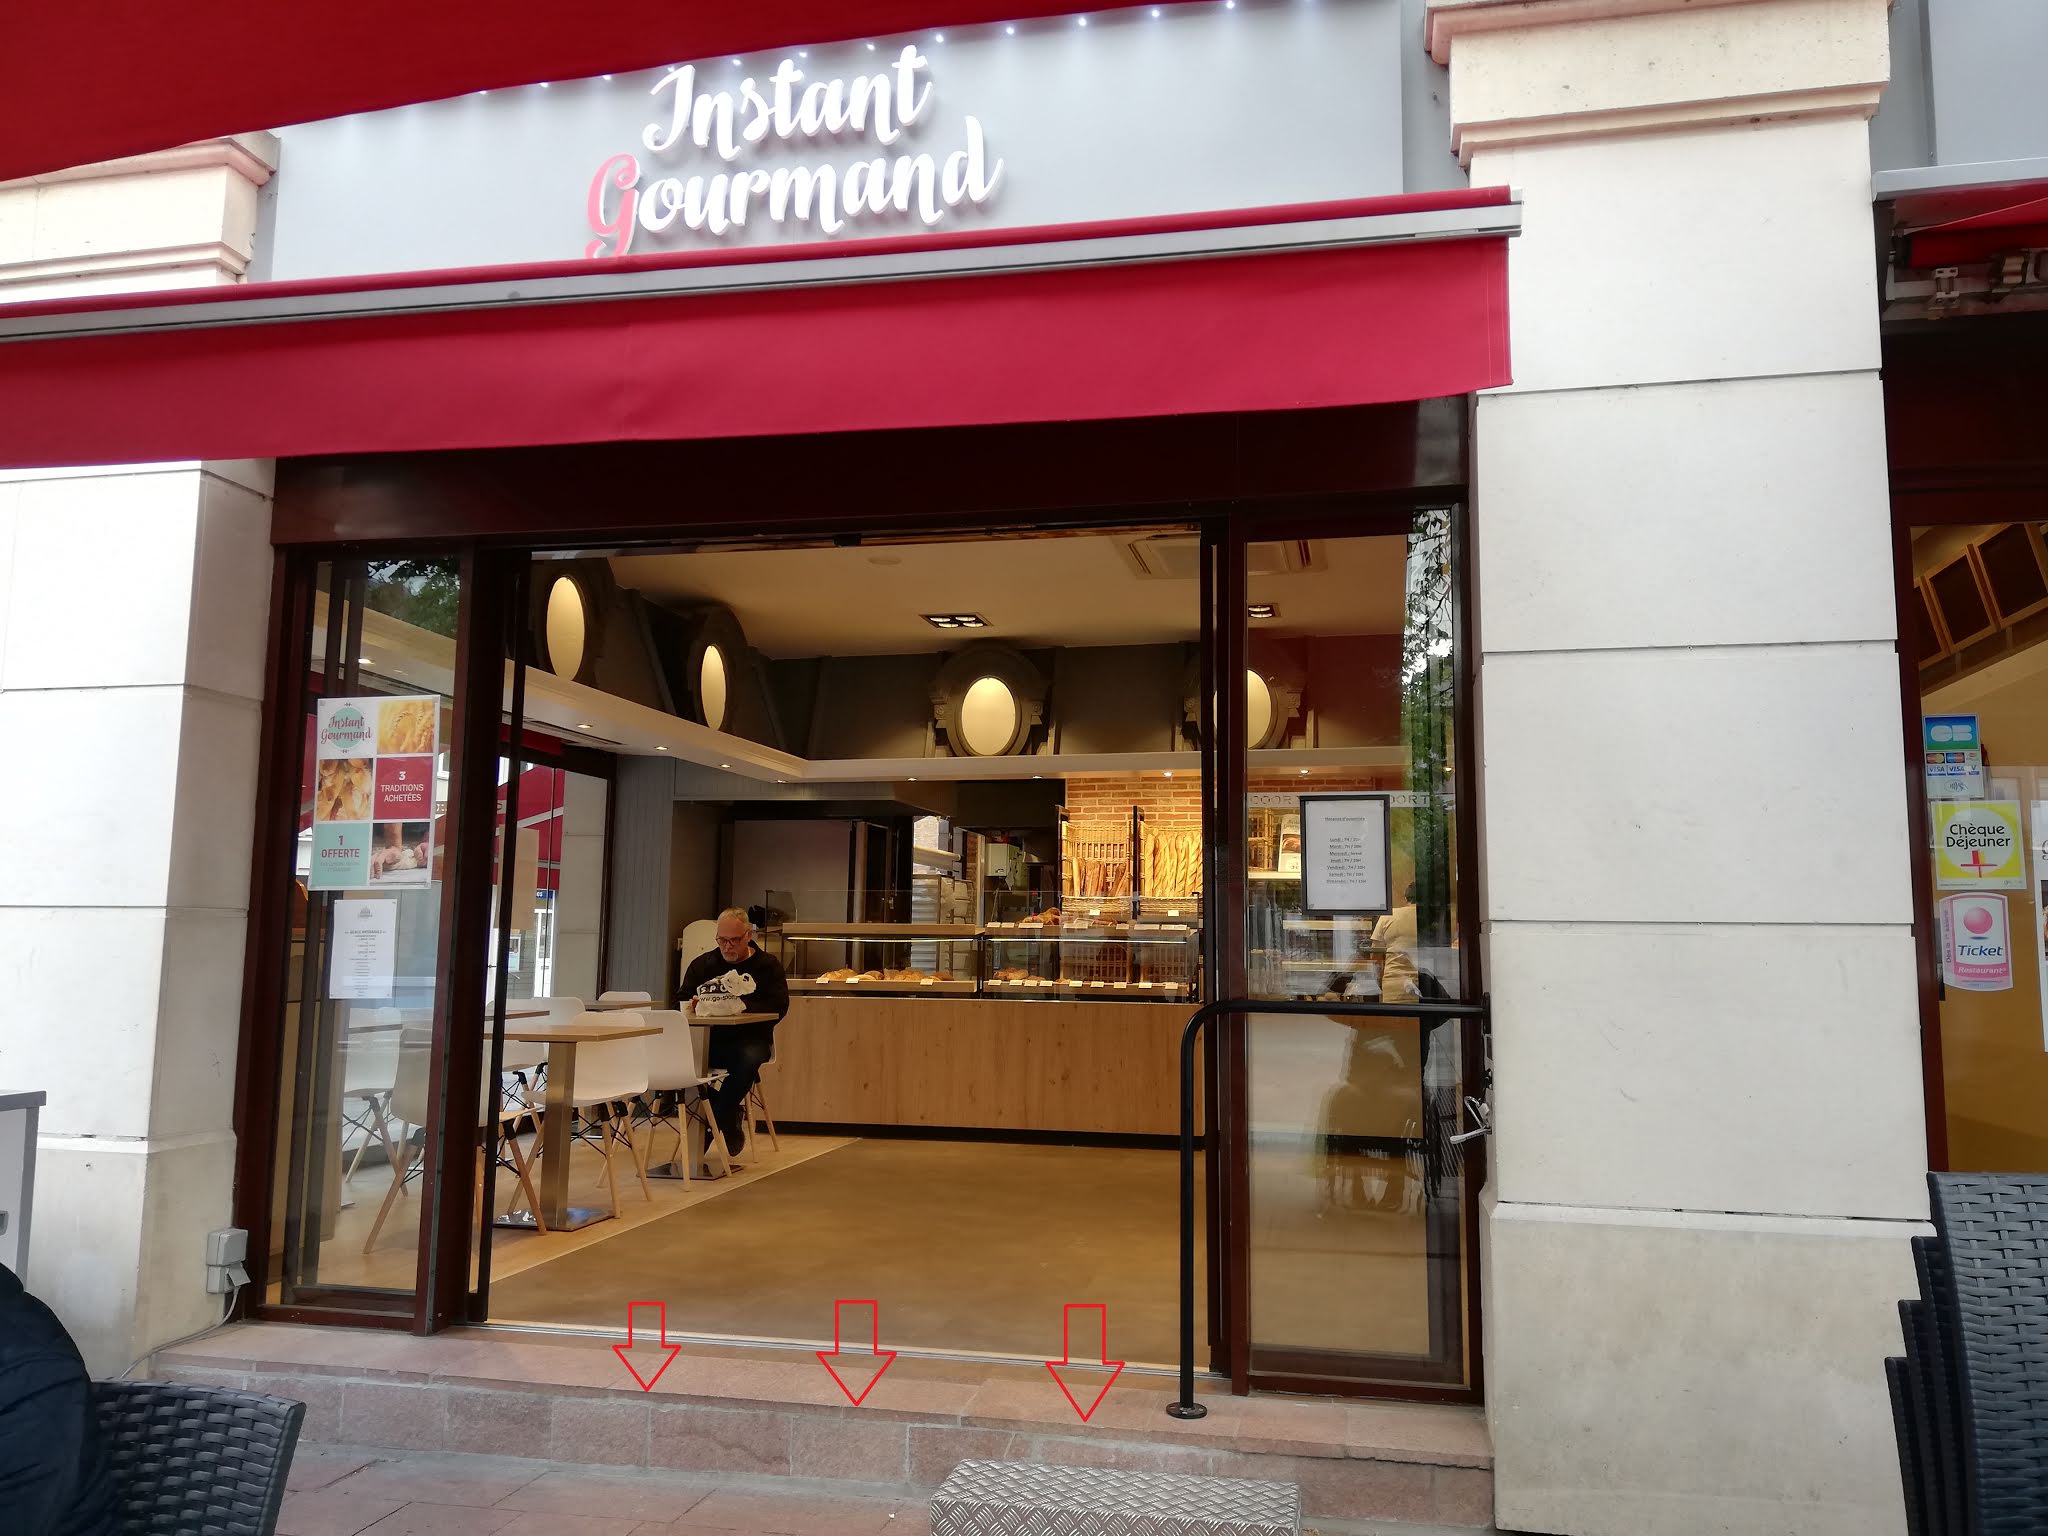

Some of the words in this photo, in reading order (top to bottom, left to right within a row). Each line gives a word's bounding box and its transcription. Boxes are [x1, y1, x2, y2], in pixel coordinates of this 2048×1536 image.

[641, 44, 933, 162] Instant
[584, 115, 1004, 258] Gourmand
[328, 715, 365, 729] Instant
[320, 727, 372, 744] Gourmand
[1930, 725, 1973, 742] CB
[398, 771, 407, 781] 3
[380, 783, 425, 792] TRADITIONS
[383, 793, 422, 802] ACHETÉES
[1949, 823, 2005, 837] Chèque
[338, 835, 344, 846] 1
[1946, 836, 2011, 850] Déjeuner
[321, 848, 360, 858] OFFERTE
[1958, 944, 2004, 957] Ticket
